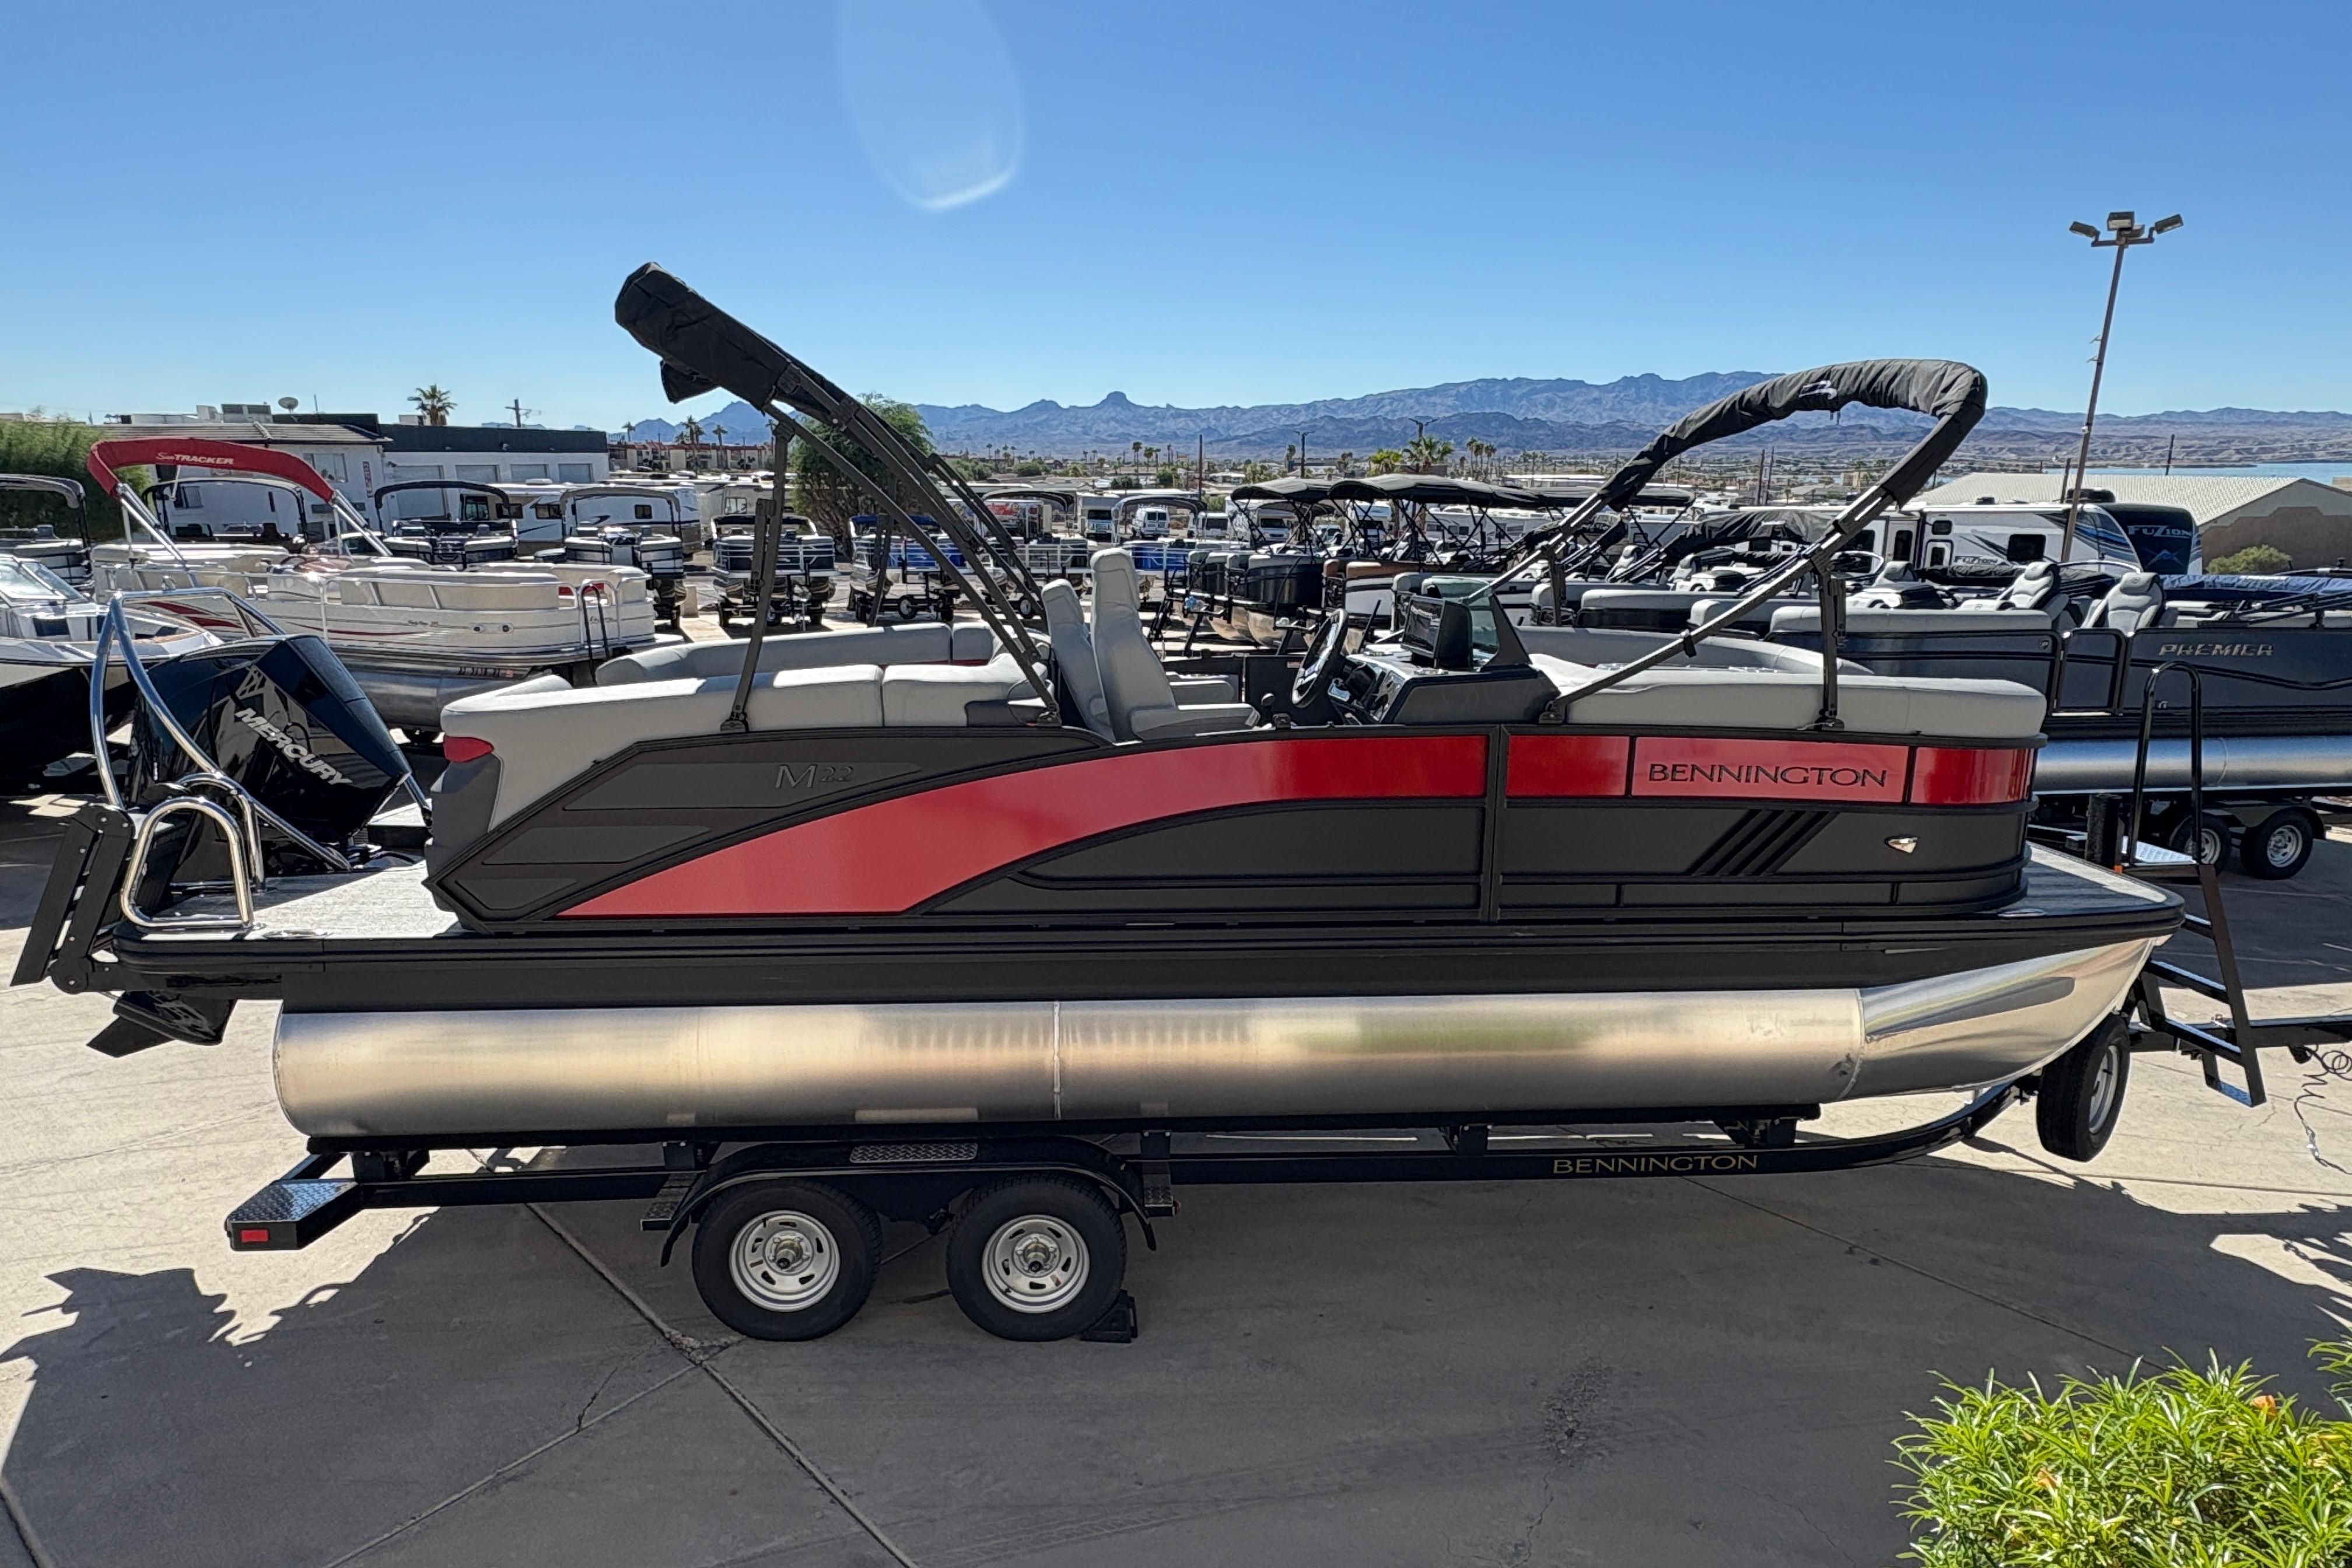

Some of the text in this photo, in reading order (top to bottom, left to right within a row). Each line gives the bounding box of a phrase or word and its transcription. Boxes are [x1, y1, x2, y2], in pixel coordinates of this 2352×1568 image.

[2159, 644, 2274, 656] PREMIER
[235, 708, 353, 785] MERCURY
[1648, 764, 1887, 788] BENNINGTON
[1553, 1155, 1758, 1174] BENNINGTON
